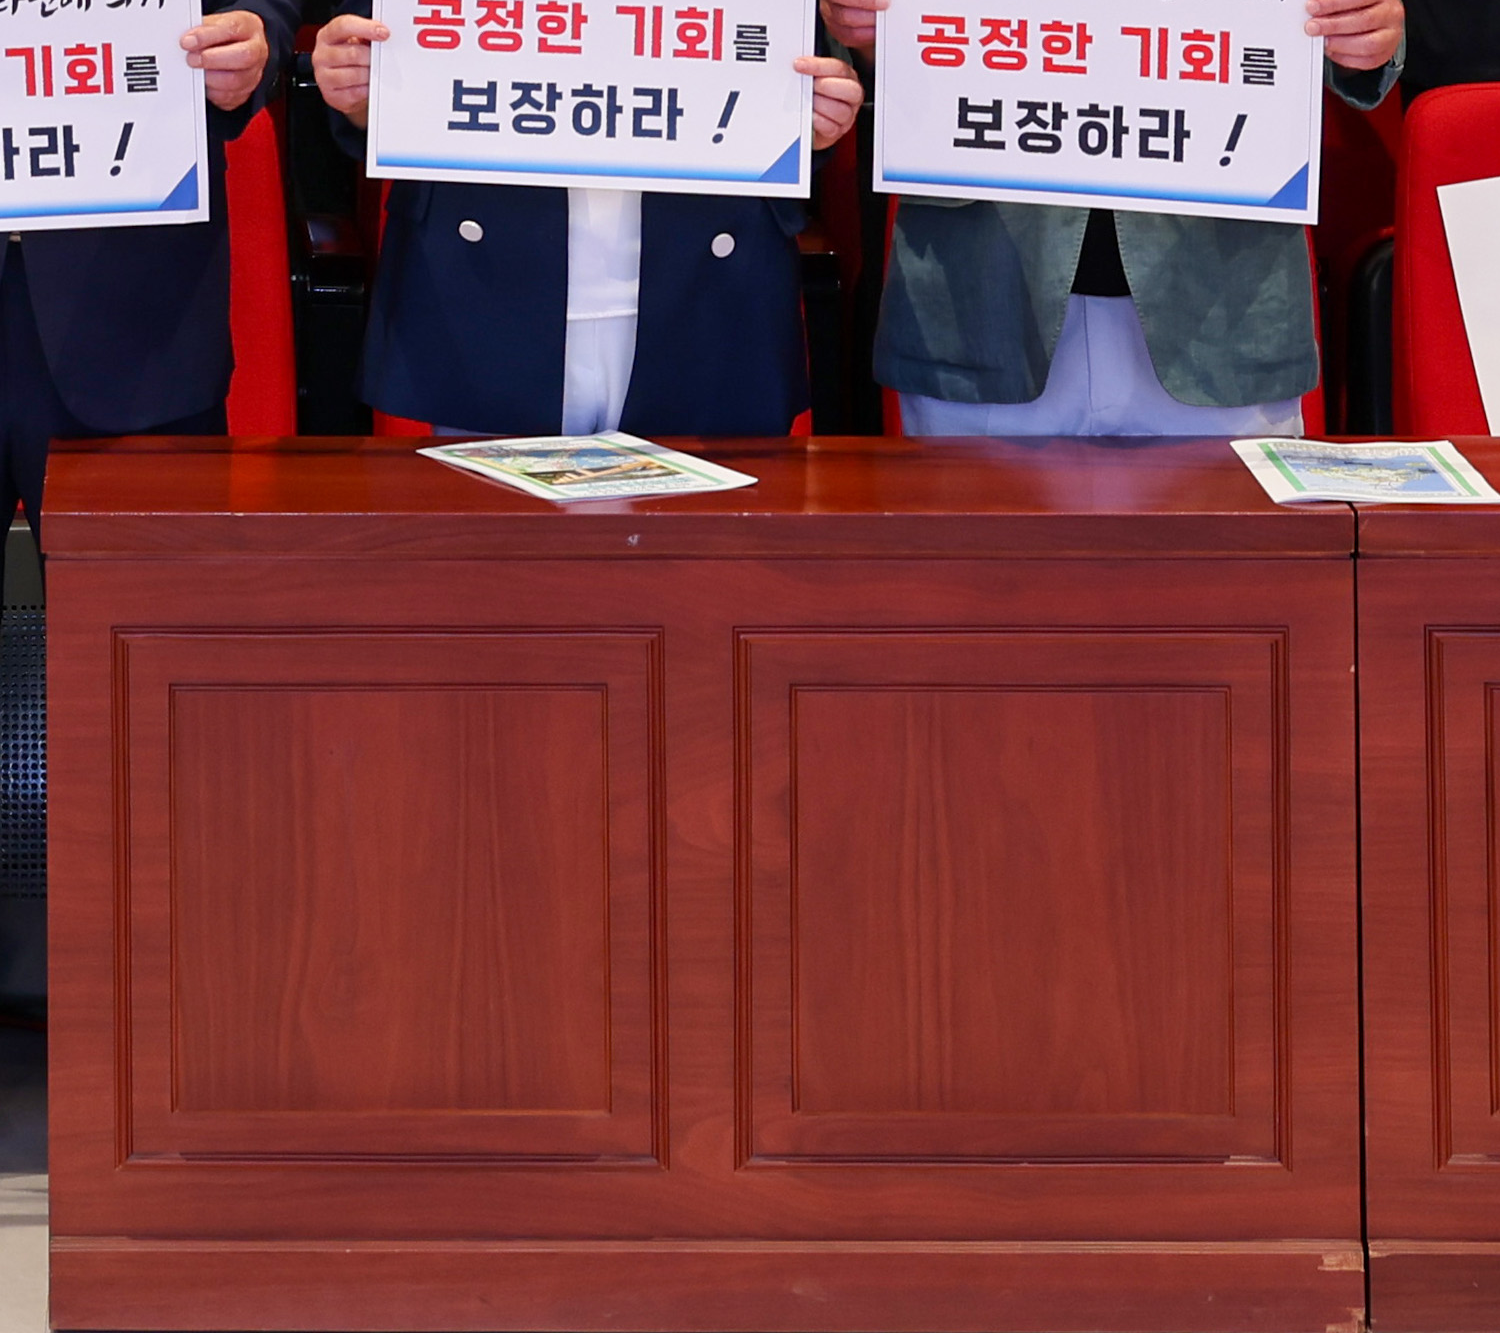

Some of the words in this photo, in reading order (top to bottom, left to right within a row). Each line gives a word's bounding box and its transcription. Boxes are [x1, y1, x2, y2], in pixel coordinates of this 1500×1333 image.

[616, 5, 769, 62] 기회를
[917, 15, 1093, 74] 공정한
[1121, 27, 1277, 85] 기회를
[5, 43, 159, 97] 기회를
[448, 79, 684, 140] 보장하라
[953, 97, 1190, 162] 보장하라
